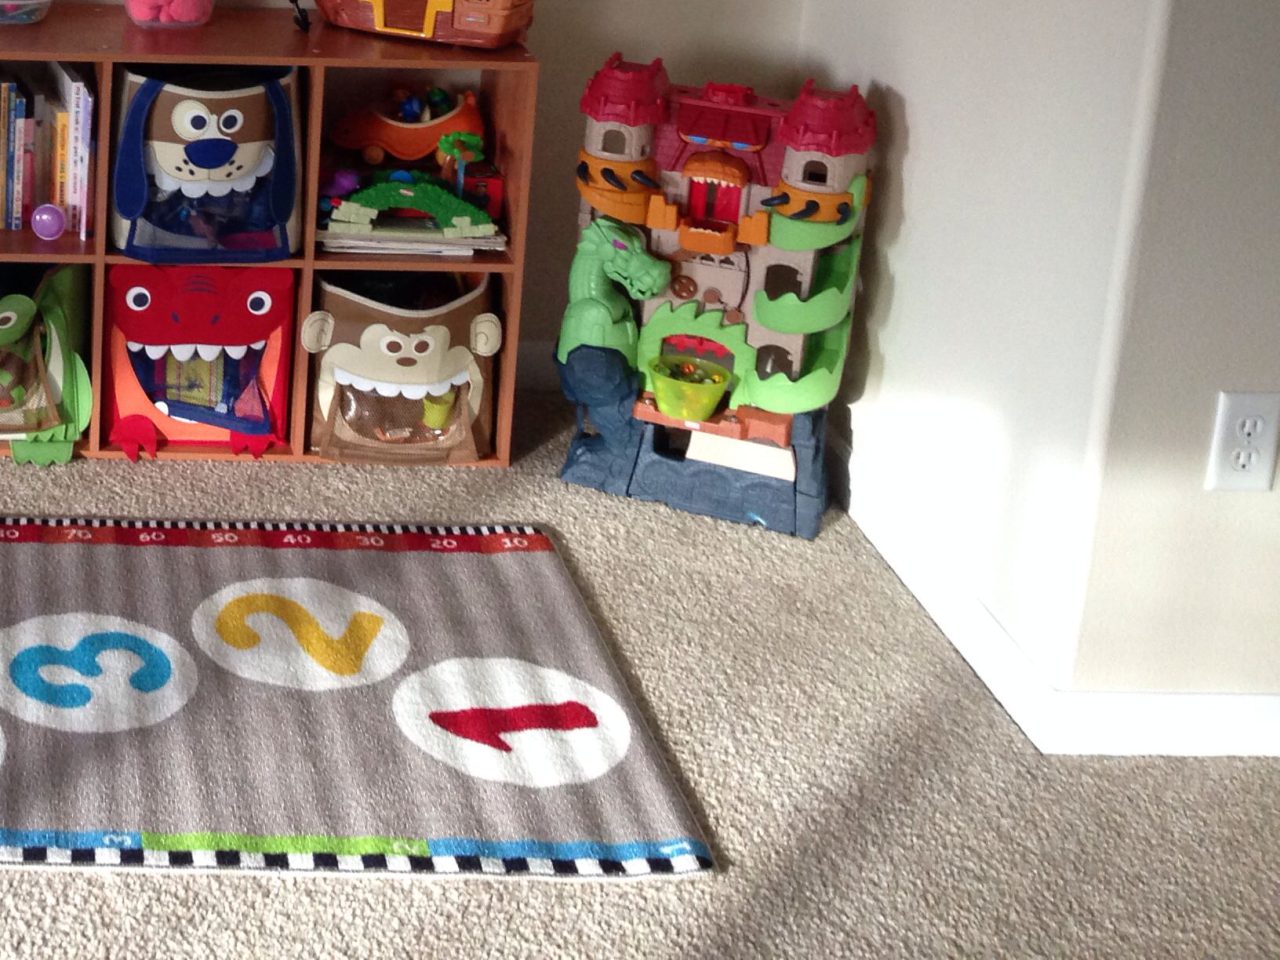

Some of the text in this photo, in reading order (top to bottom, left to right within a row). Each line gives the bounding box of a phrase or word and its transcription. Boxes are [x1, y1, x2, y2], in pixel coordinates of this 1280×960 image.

[65, 529, 92, 540] 70
[139, 531, 165, 542] 60
[212, 532, 237, 543] 50
[282, 534, 312, 544] 40
[355, 535, 385, 546] 30
[429, 538, 457, 548] 20
[501, 537, 528, 547] 10
[215, 593, 384, 676] 2
[9, 631, 172, 708] 3
[429, 700, 599, 752] 1
